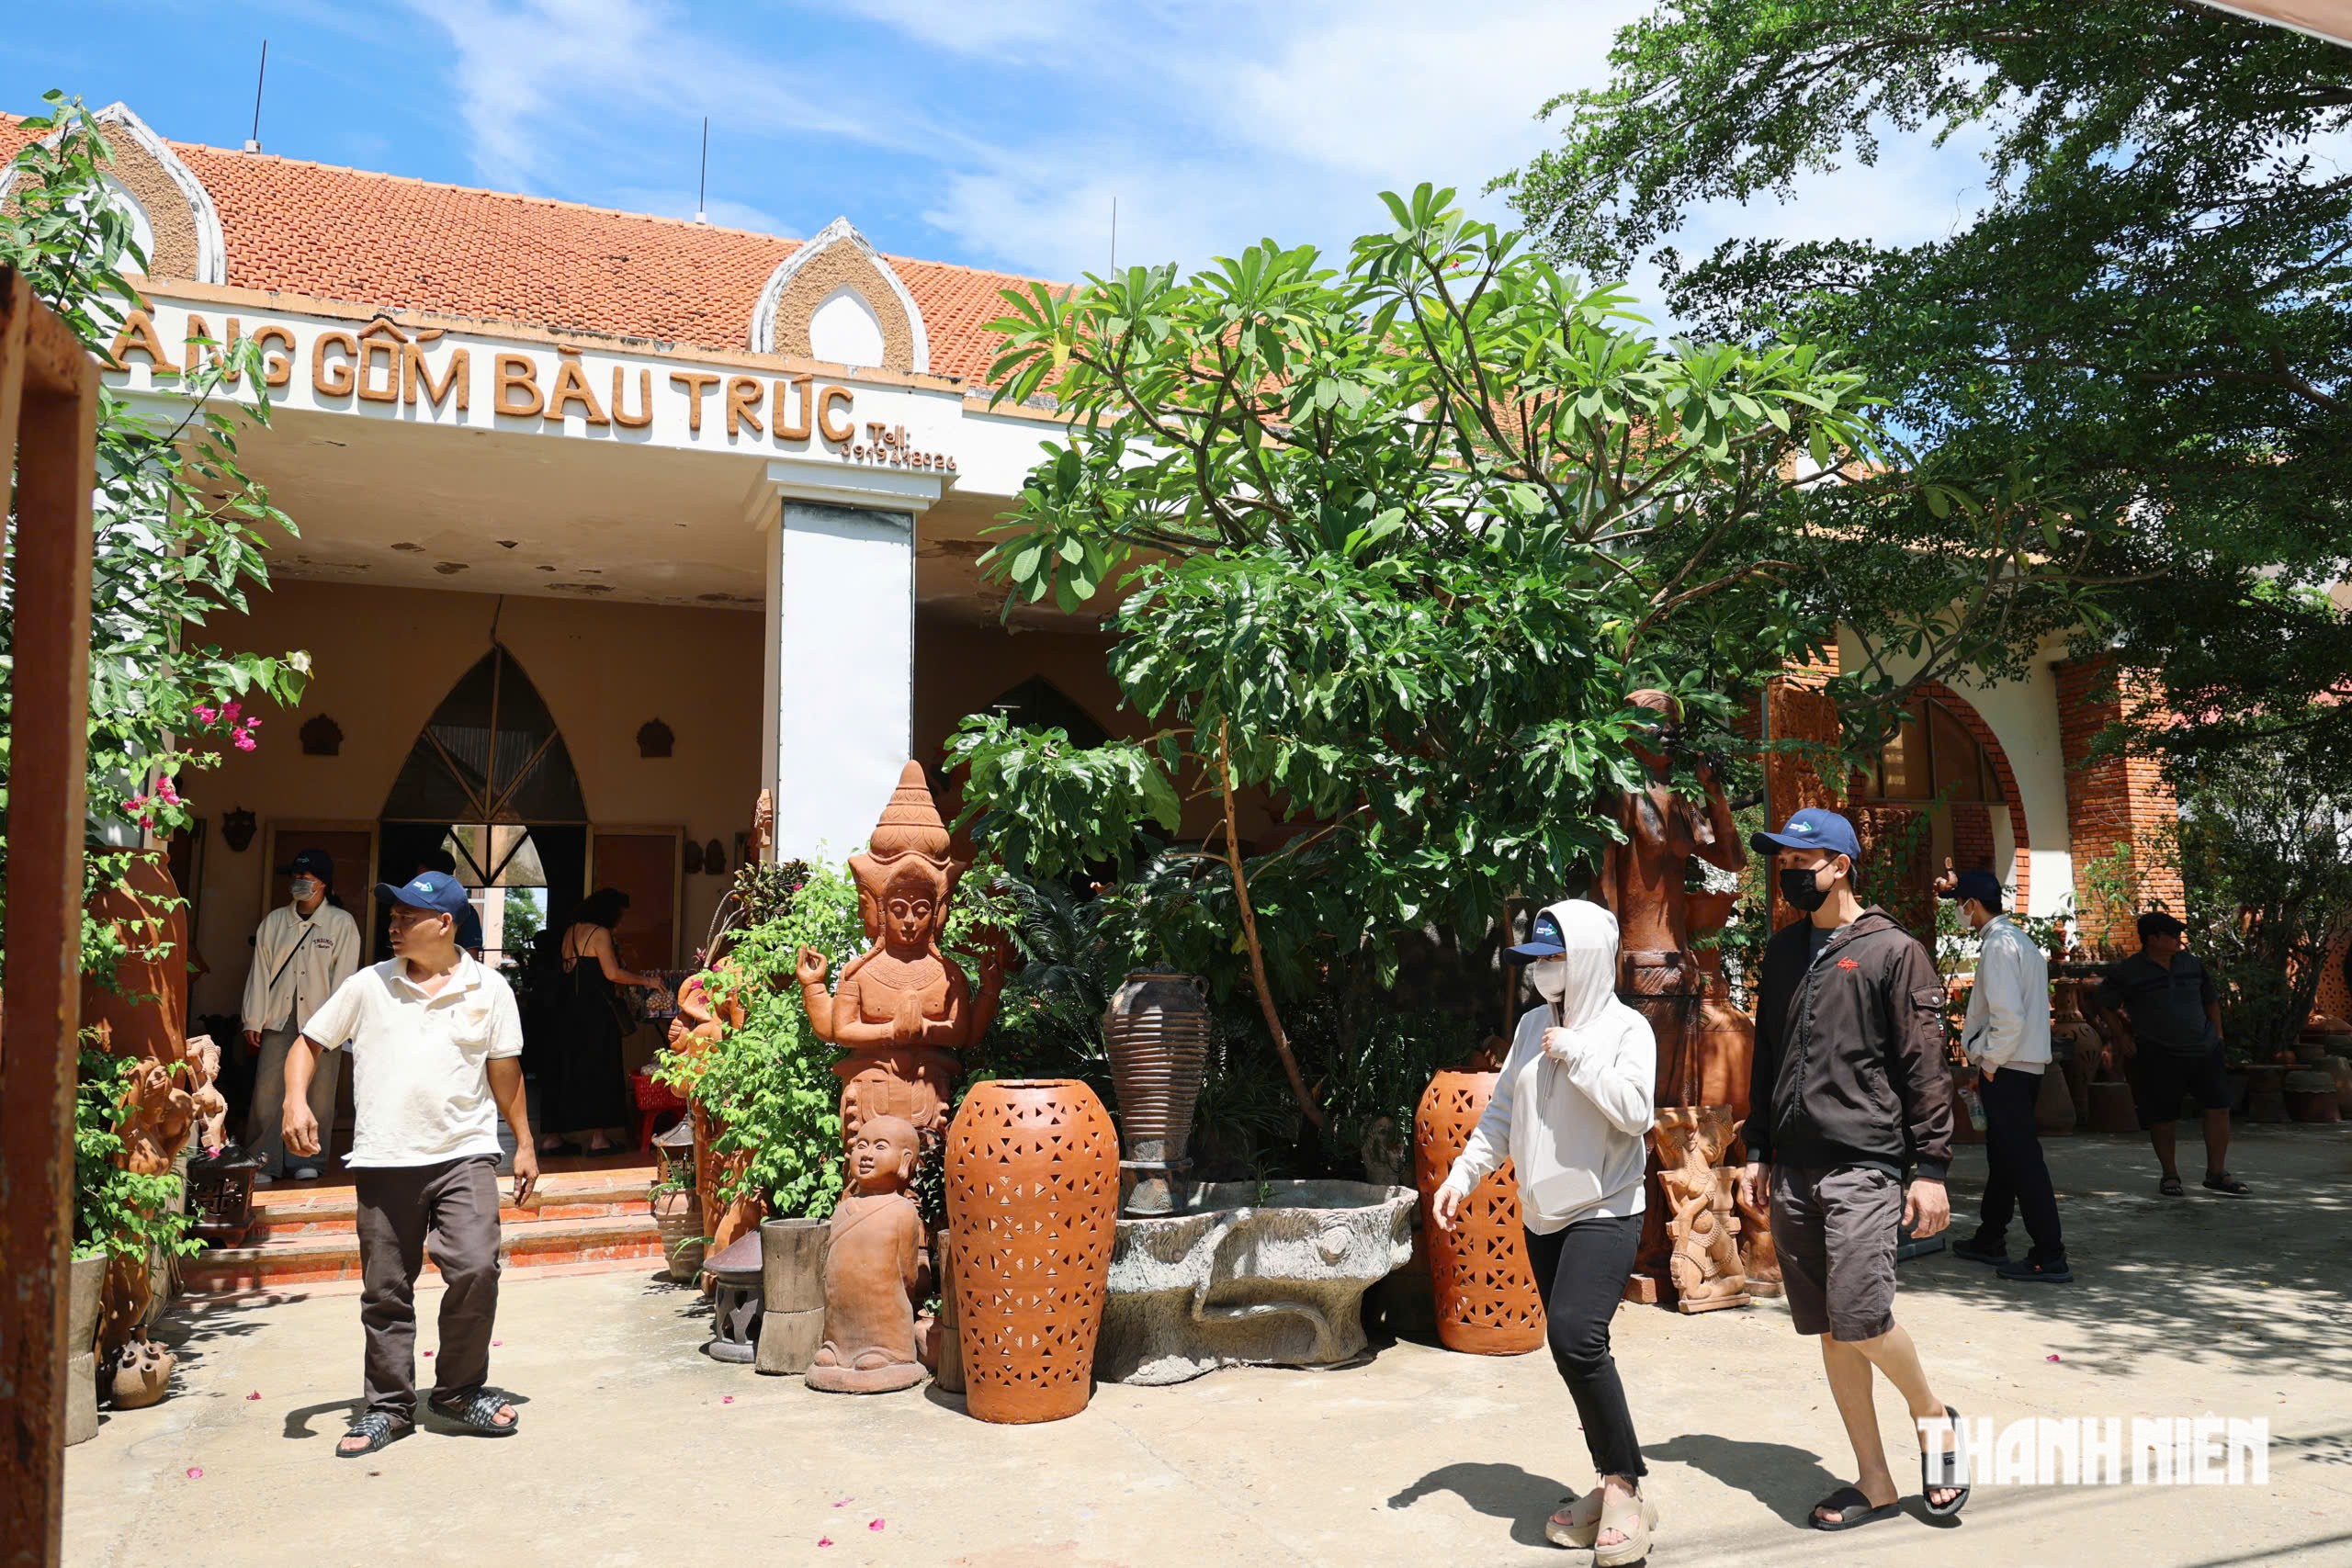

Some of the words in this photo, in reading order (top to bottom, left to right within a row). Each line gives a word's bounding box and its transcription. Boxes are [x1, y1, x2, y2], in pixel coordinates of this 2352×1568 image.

[59, 292, 296, 387] ÀNG
[312, 318, 470, 410] GỐM
[494, 344, 653, 428] BÀU
[669, 371, 855, 442] TRÚC
